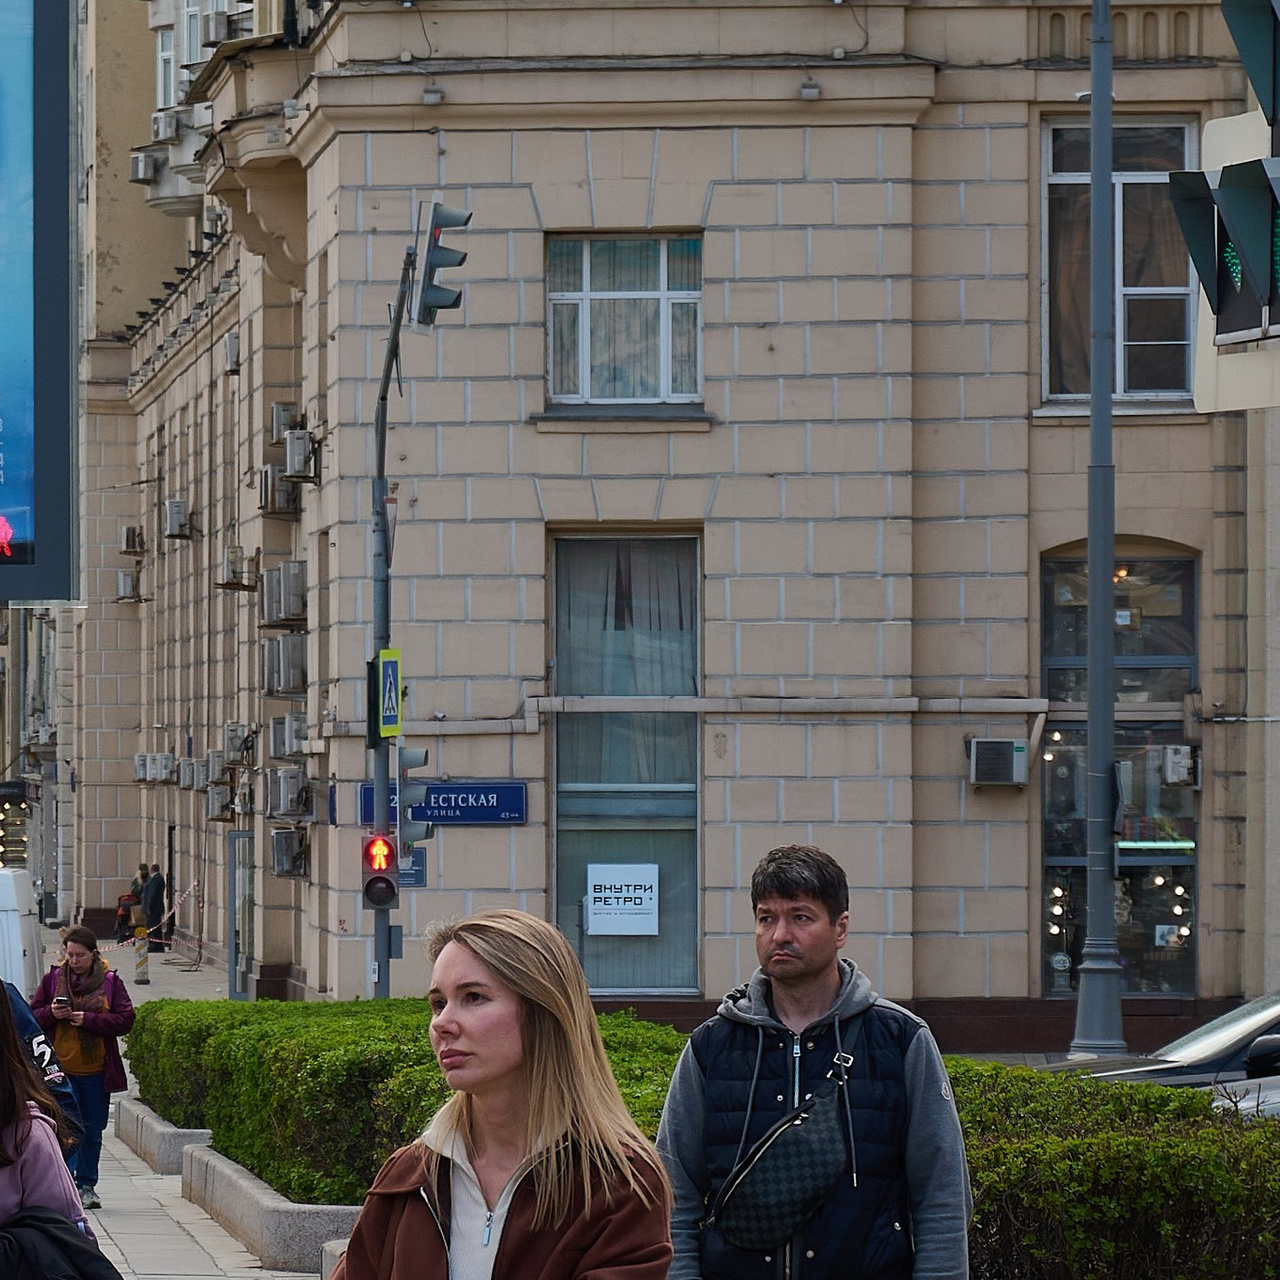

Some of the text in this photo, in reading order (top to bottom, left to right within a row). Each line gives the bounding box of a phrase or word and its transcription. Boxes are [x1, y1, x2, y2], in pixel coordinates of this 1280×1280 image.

[412, 794, 497, 807] ЕСТСКАЯ
[593, 884, 653, 894] ВНУТРИ
[593, 897, 643, 906] РЕТРО
[32, 1034, 52, 1068] 5
